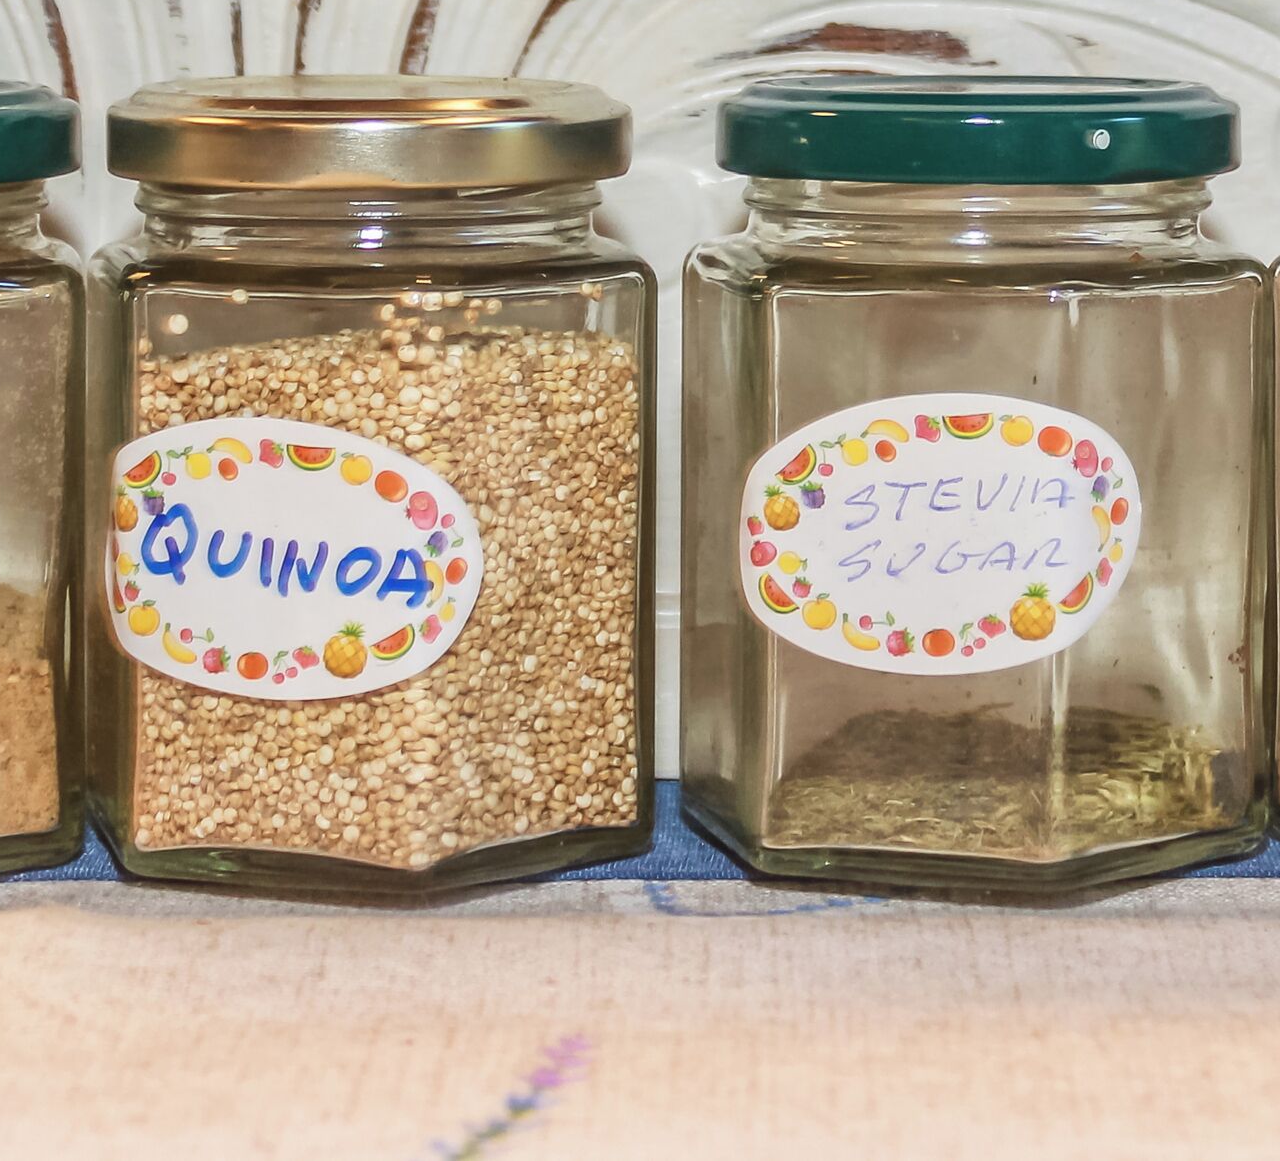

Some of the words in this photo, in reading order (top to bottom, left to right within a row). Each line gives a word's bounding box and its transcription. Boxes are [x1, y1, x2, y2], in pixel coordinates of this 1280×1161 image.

[844, 473, 1076, 531] STEVIA
[140, 502, 435, 610] QUINOA
[837, 538, 1069, 583] SUGAR
